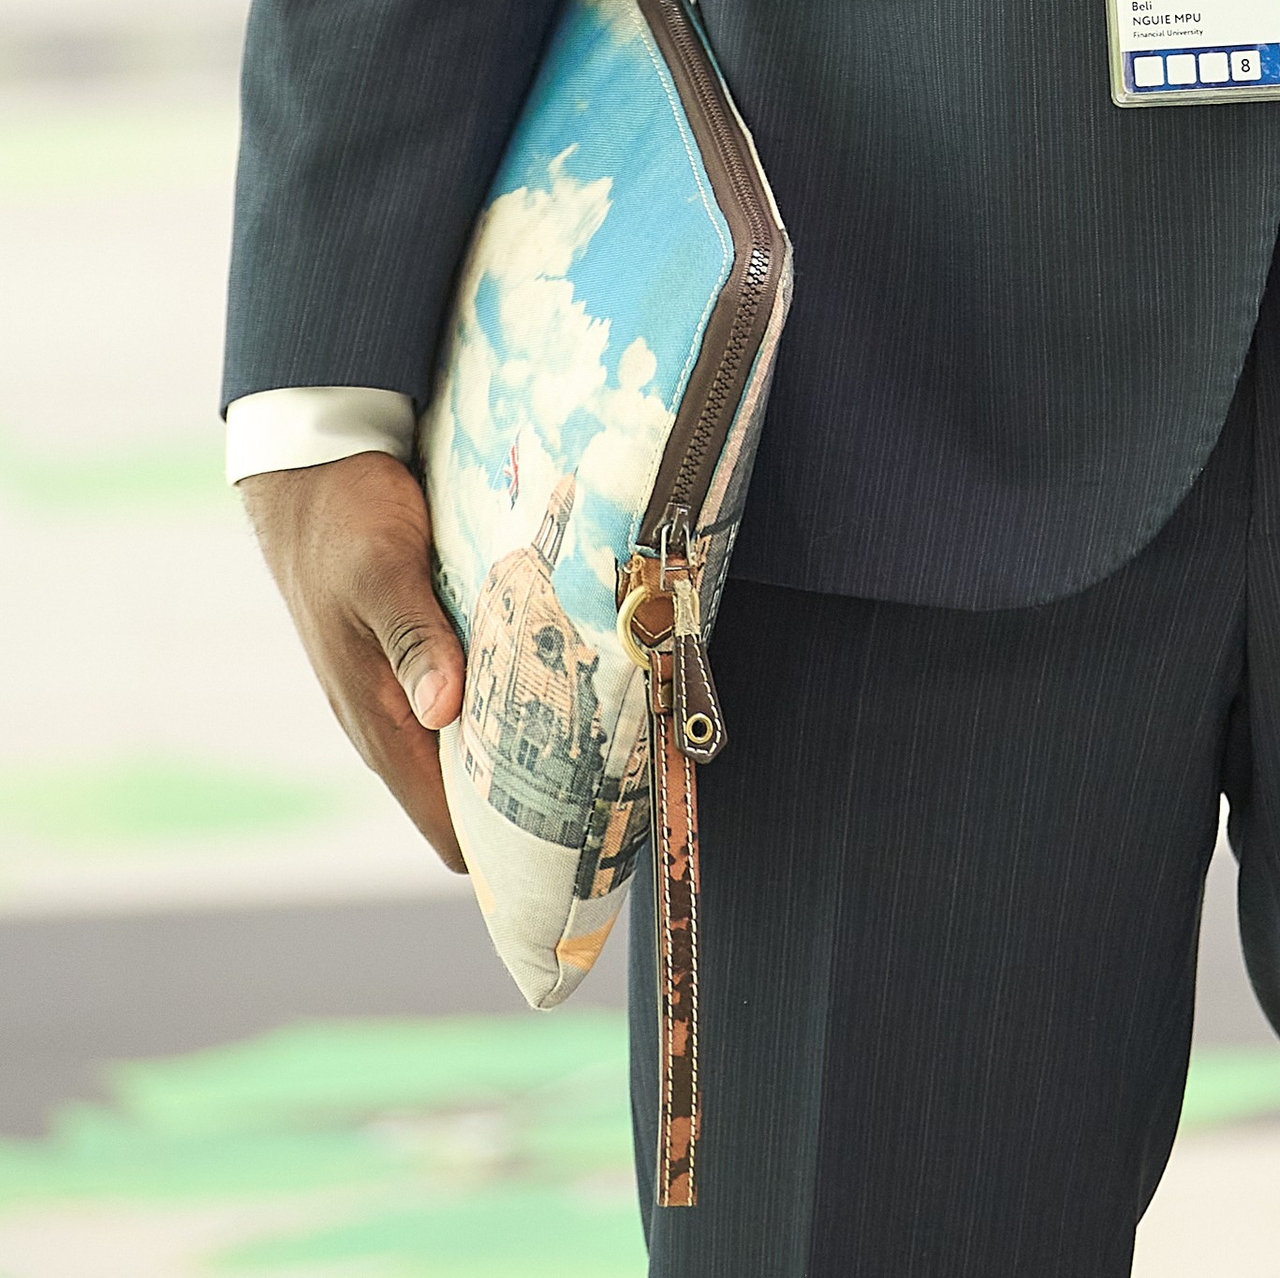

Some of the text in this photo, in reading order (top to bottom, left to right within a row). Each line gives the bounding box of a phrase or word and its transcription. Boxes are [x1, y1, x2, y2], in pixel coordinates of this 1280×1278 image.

[1133, 13, 1202, 26] NGUIE MPU
[1167, 29, 1203, 37] University
[1241, 58, 1251, 73] 8
